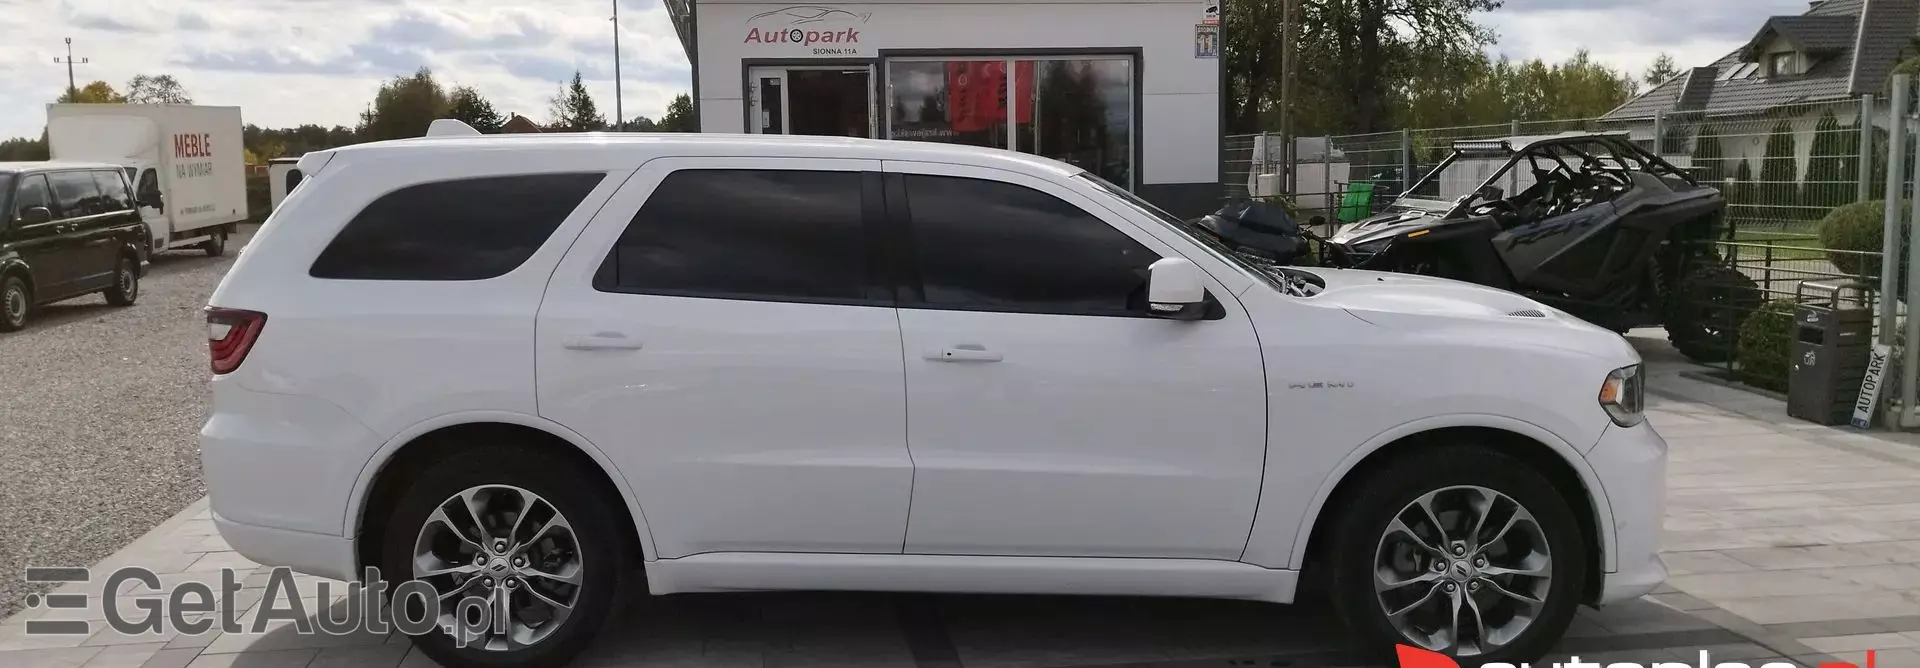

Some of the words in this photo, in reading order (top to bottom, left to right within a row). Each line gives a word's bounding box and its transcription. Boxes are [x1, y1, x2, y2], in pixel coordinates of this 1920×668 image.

[744, 28, 859, 46] Autopark
[174, 133, 212, 158] MEBLE
[176, 163, 186, 178] NA
[188, 161, 213, 178] WYMIAR
[1857, 352, 1886, 413] AUTOPARK
